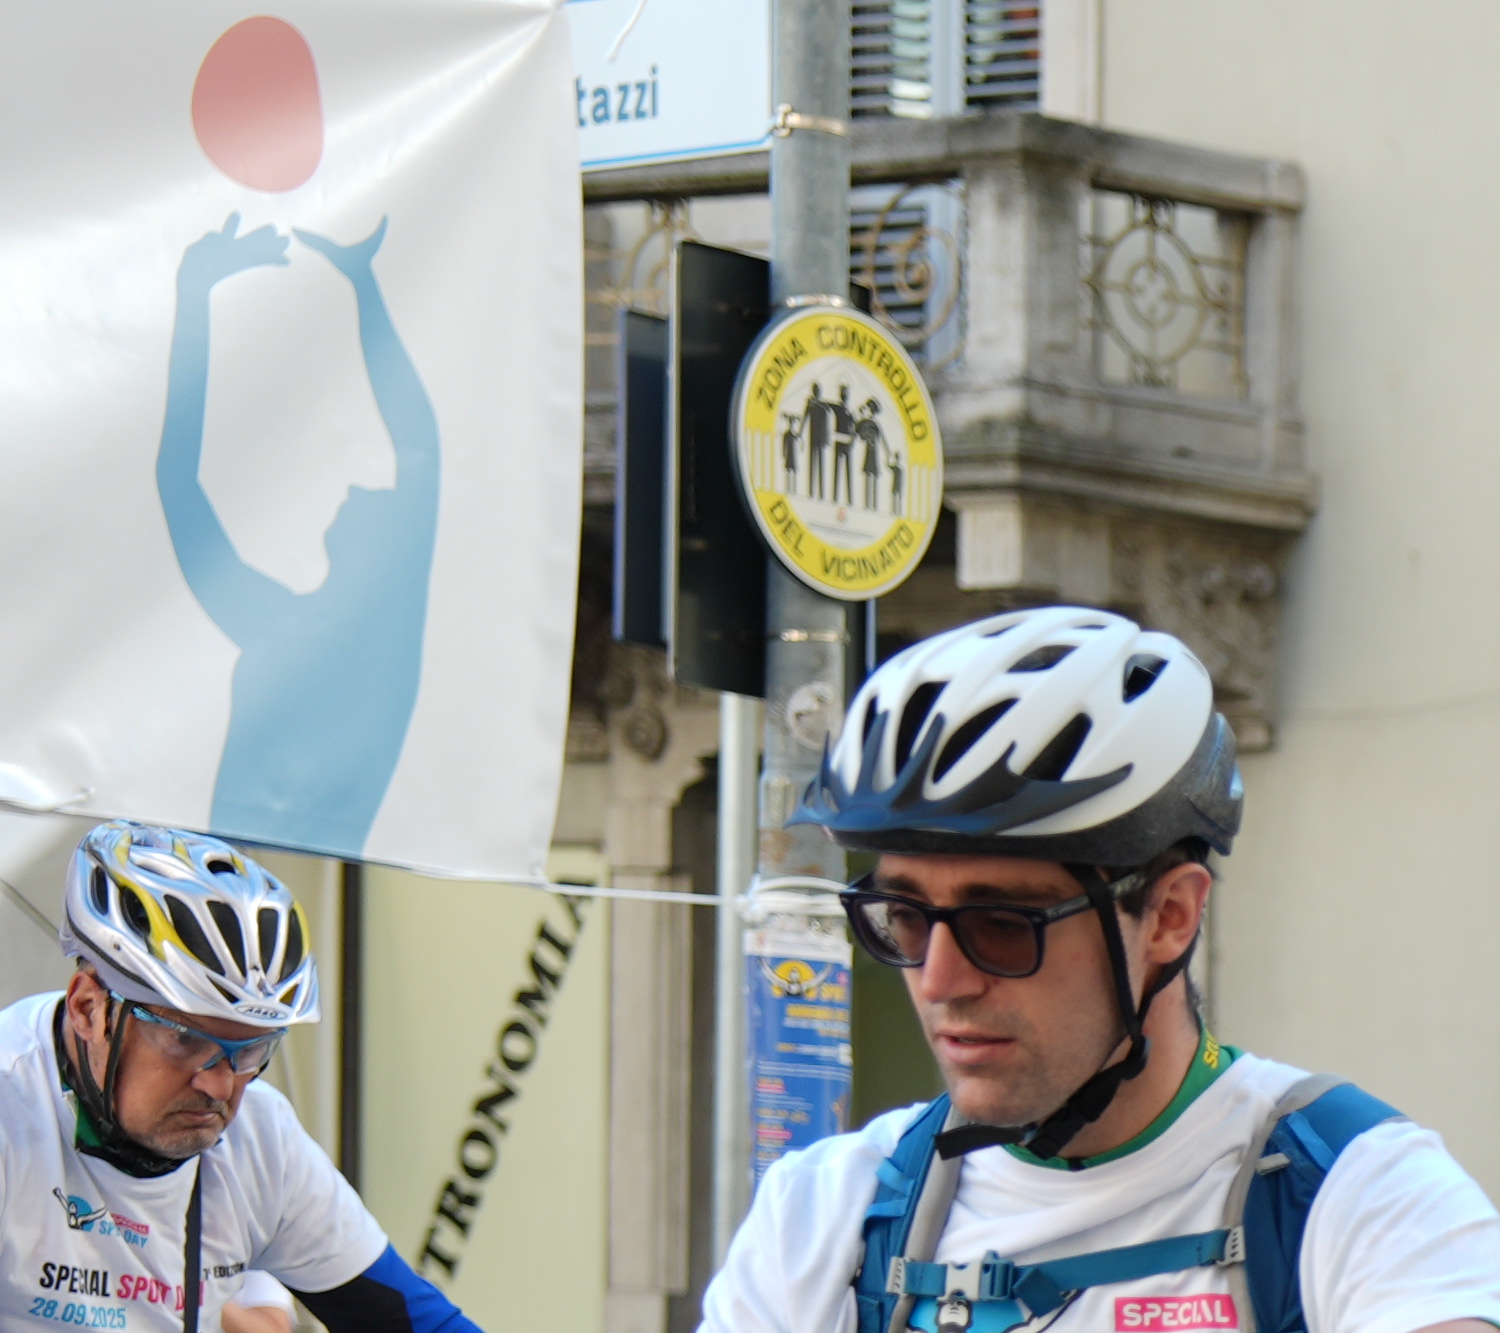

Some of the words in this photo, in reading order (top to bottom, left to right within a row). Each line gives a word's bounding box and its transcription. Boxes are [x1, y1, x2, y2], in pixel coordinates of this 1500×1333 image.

[575, 64, 659, 128] tazzi
[757, 337, 807, 411] ZONA
[817, 324, 928, 442] CONTROLLO
[769, 499, 806, 559] DEL
[819, 524, 915, 581] VICINATO
[419, 873, 599, 1286] TRONOMIA
[28, 1297, 128, 1330] 28.09.2025
[116, 1274, 171, 1304] SPOT
[1121, 1302, 1231, 1328] SPECIAL
